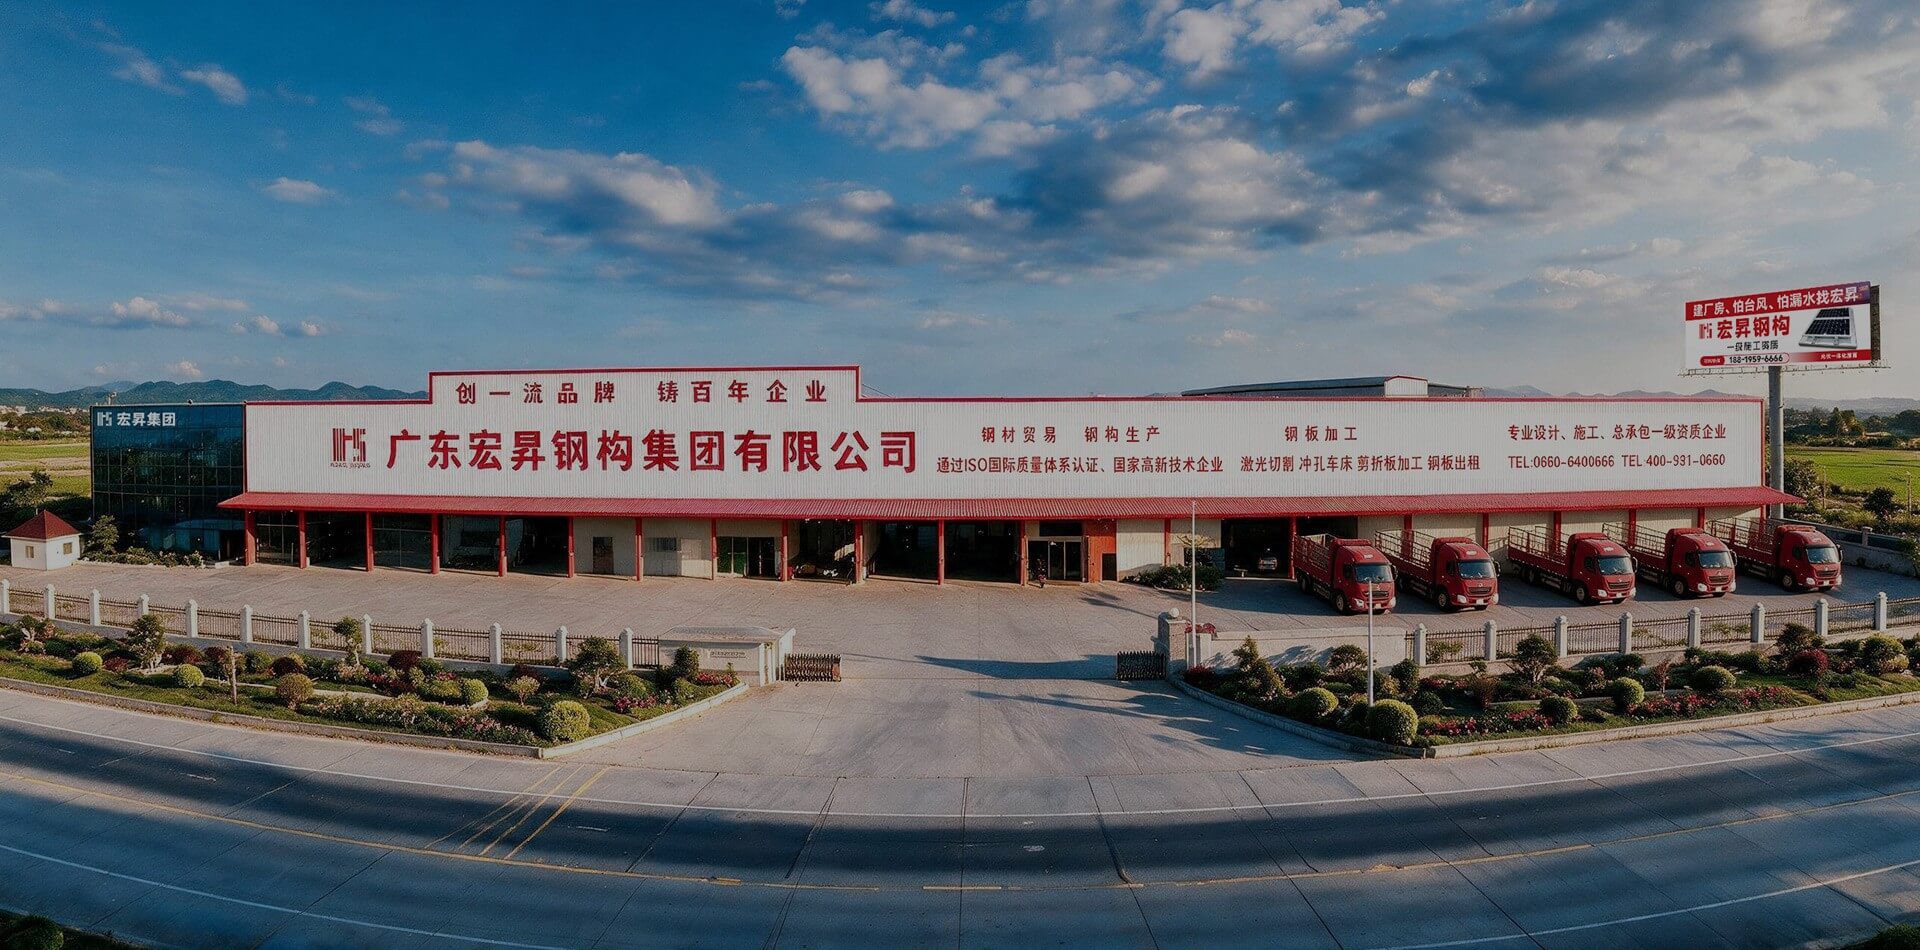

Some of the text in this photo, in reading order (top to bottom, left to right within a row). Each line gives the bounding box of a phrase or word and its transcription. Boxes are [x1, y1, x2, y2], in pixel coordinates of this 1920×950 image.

[1692, 286, 1859, 317] 建厂房、怕台风、怕漏水找宏昇
[1717, 315, 1790, 339] 宏昇钢构
[1729, 355, 1784, 363] 188-1959-6666
[455, 379, 827, 404] 创一流品牌 铸百年企业
[117, 412, 176, 427] 宏昇集团
[981, 425, 1160, 443] 钢材贸易 钢构生产
[1284, 425, 1358, 442] 钢板加工
[1508, 424, 1726, 441] 专业设计、施工、总承包一级资质企业
[387, 428, 917, 474] 广东宏昇钢构集团有限公司
[936, 456, 1224, 473] 通过ISO国际质量体系认证、国家高新技术企业
[1240, 454, 1481, 472] 激光切割 冲孔车床 剪折板加工 钢板出租
